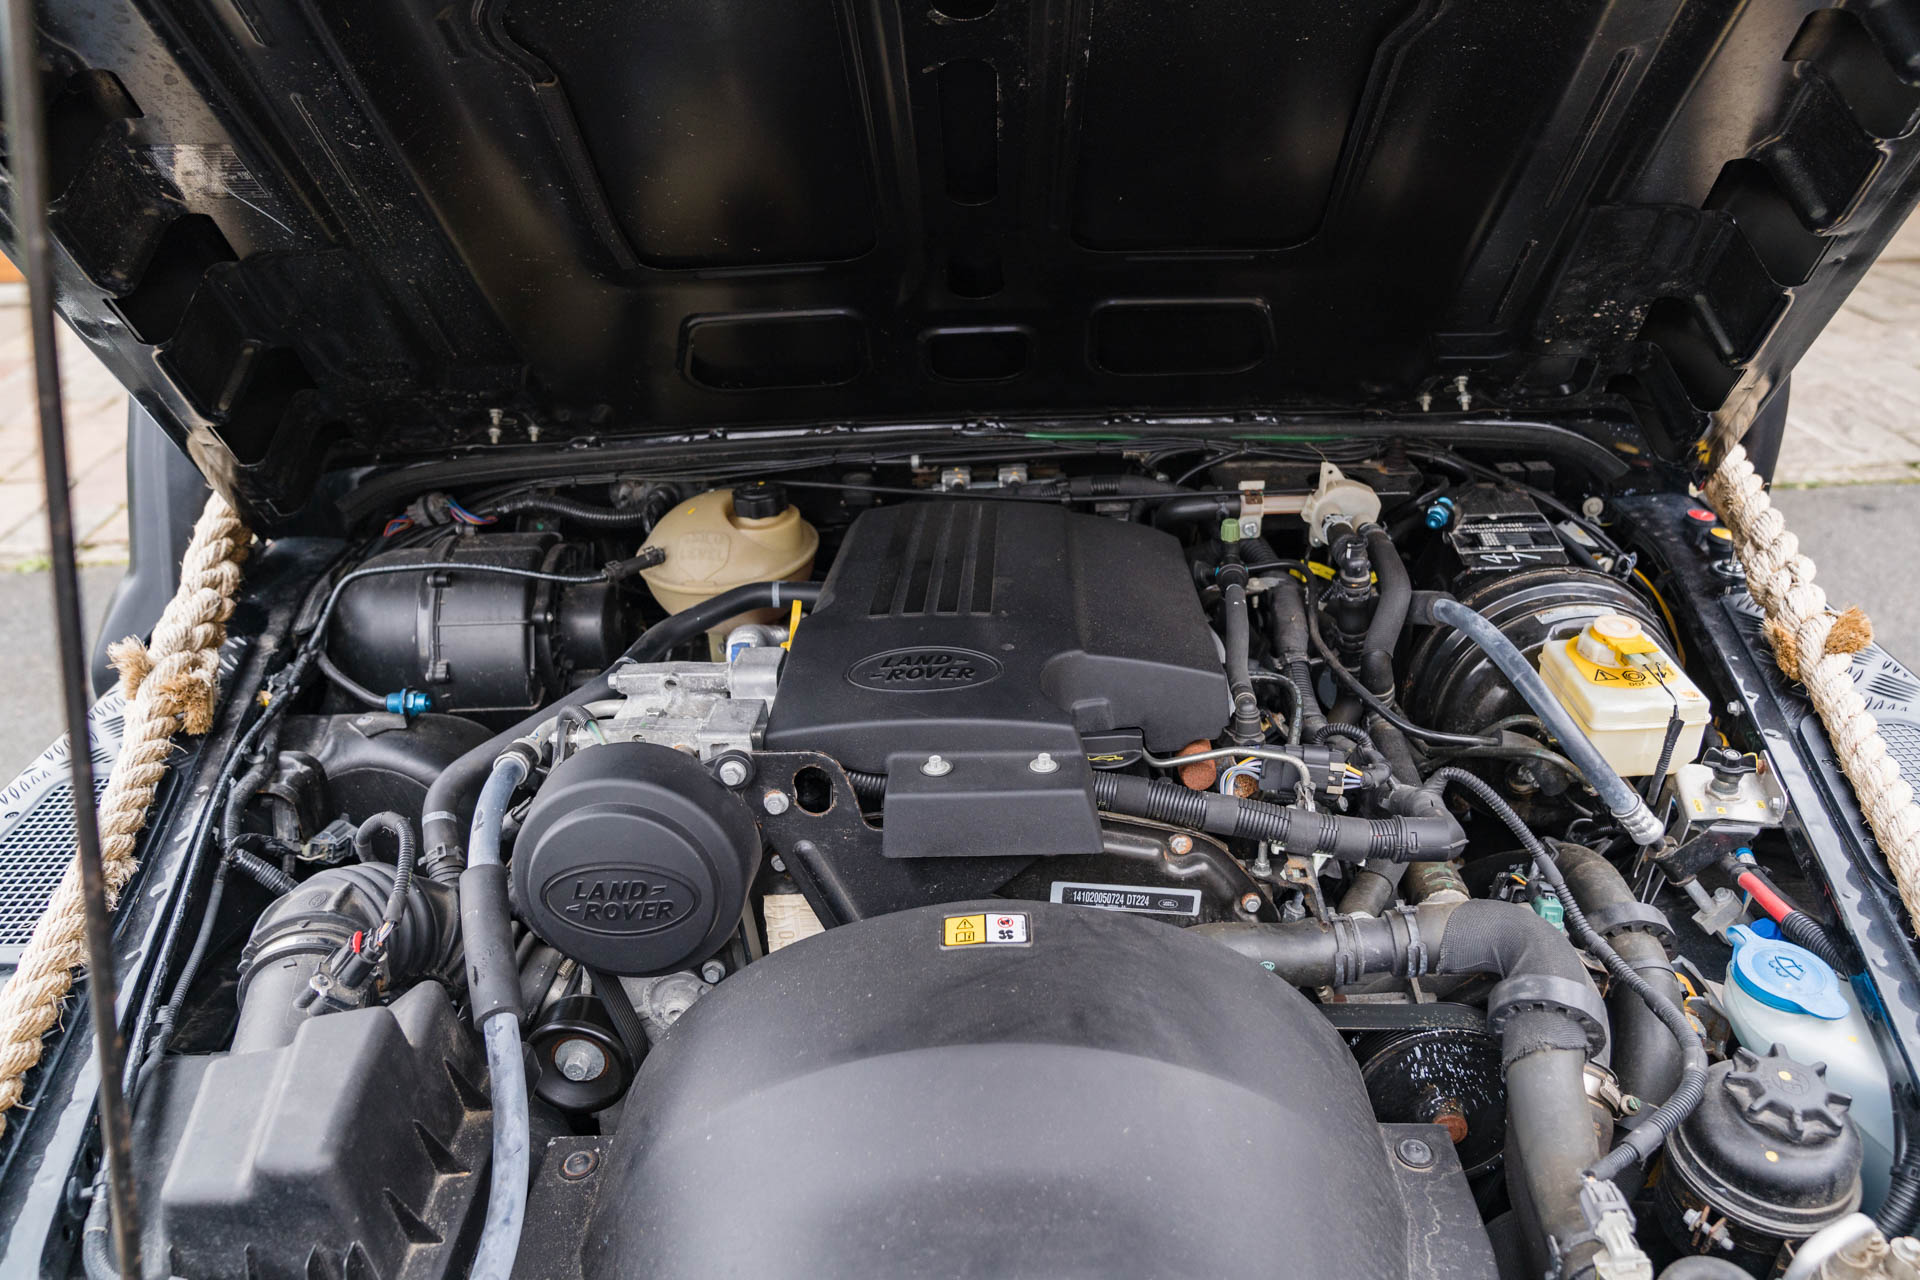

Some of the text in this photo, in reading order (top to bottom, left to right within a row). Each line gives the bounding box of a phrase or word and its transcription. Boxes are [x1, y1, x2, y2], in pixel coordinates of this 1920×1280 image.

[880, 655, 953, 668] LAND
[884, 667, 976, 681] ROVER
[572, 880, 648, 900] LAND
[1126, 894, 1150, 906] DT224
[582, 900, 675, 921] ROVER
